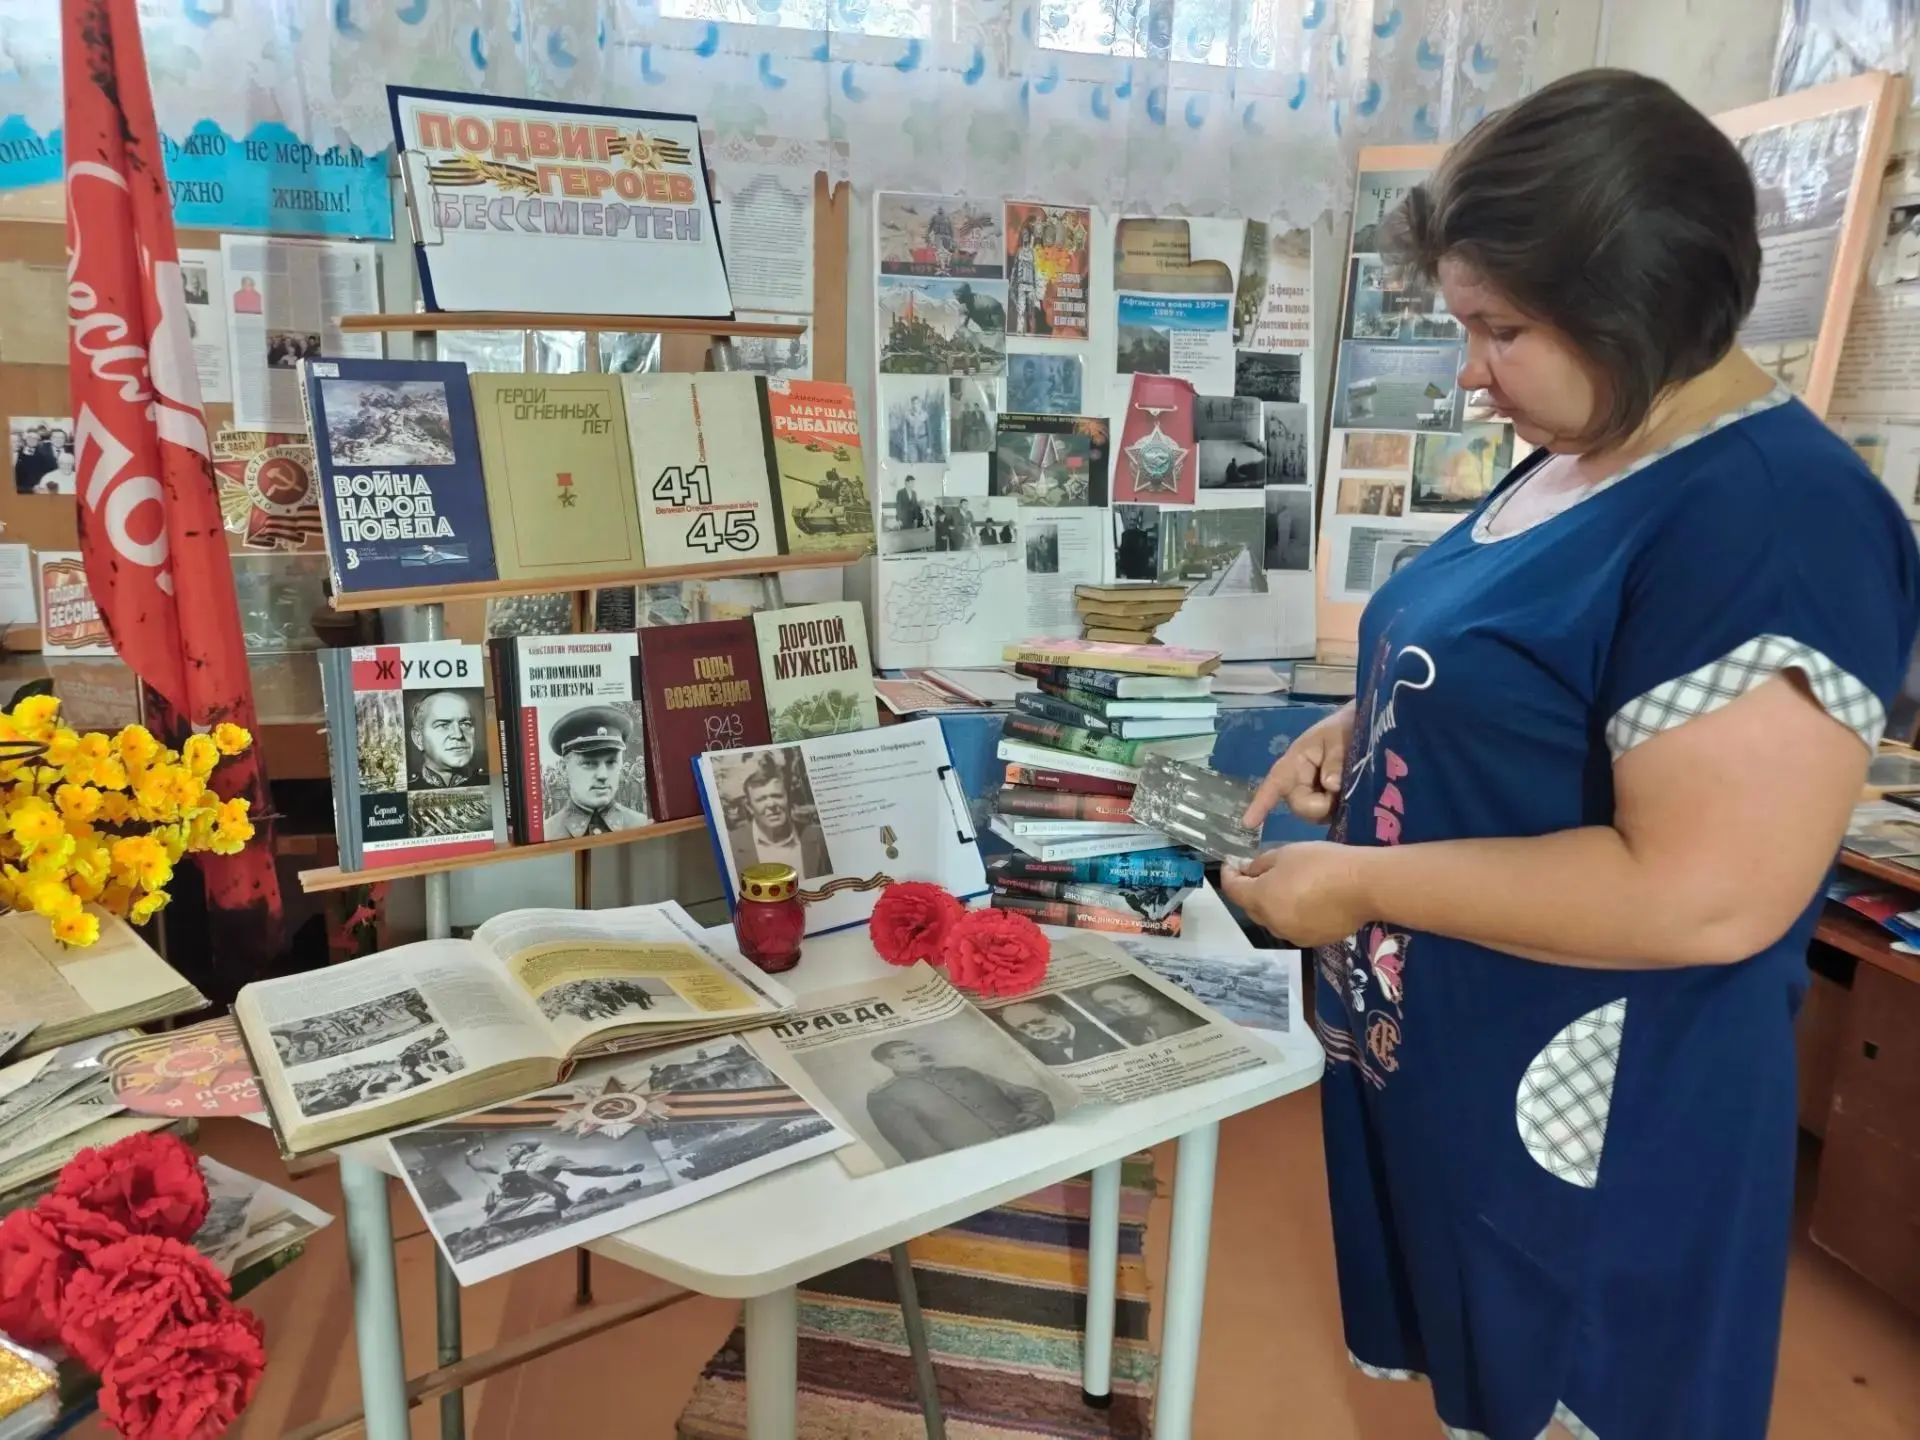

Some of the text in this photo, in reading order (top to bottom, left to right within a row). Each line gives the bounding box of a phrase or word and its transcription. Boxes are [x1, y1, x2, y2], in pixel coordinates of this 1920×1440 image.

[416, 110, 619, 162] ПОДВИГ
[245, 140, 268, 162] не
[167, 180, 351, 213] ужно живым!
[535, 163, 698, 205] ГЕРОЕВ
[432, 192, 701, 241] БЕССМЕРТЕН
[496, 388, 547, 404] ГЕРОИ
[514, 403, 600, 420] ОГНЕННЫХ
[790, 404, 857, 420] МАРШАЛ
[582, 419, 613, 434] ЛЕТ
[774, 416, 858, 436] РЫБАЛКО
[228, 442, 256, 452] ЗАБЫТ
[333, 471, 433, 498] ВОЙНА
[652, 465, 713, 506] 41
[336, 496, 436, 520] НАРОД
[655, 501, 759, 515] Великая Отечественная война
[339, 517, 455, 542] ПОБЕДА
[686, 510, 760, 553] 45
[345, 549, 360, 570] 3
[48, 600, 100, 628] БЕССМЕ
[778, 615, 846, 651] ДОРОГОЙ
[375, 658, 470, 680] ЖУКОВ
[529, 664, 601, 680] ВОСПОМИНАНИЯ
[693, 655, 734, 680] ГОДЫ
[772, 645, 858, 680] МУЖЕСТВА
[529, 684, 548, 699] БЕЗ
[550, 682, 593, 698] ЦЕНЗУРЫ
[664, 679, 751, 711] ВОЗМЕЗДИЯ
[704, 714, 744, 739] 1943
[768, 1002, 895, 1039] ПРАВДА
[195, 1076, 263, 1101] ПОМ
[230, 1088, 260, 1102] ГО
